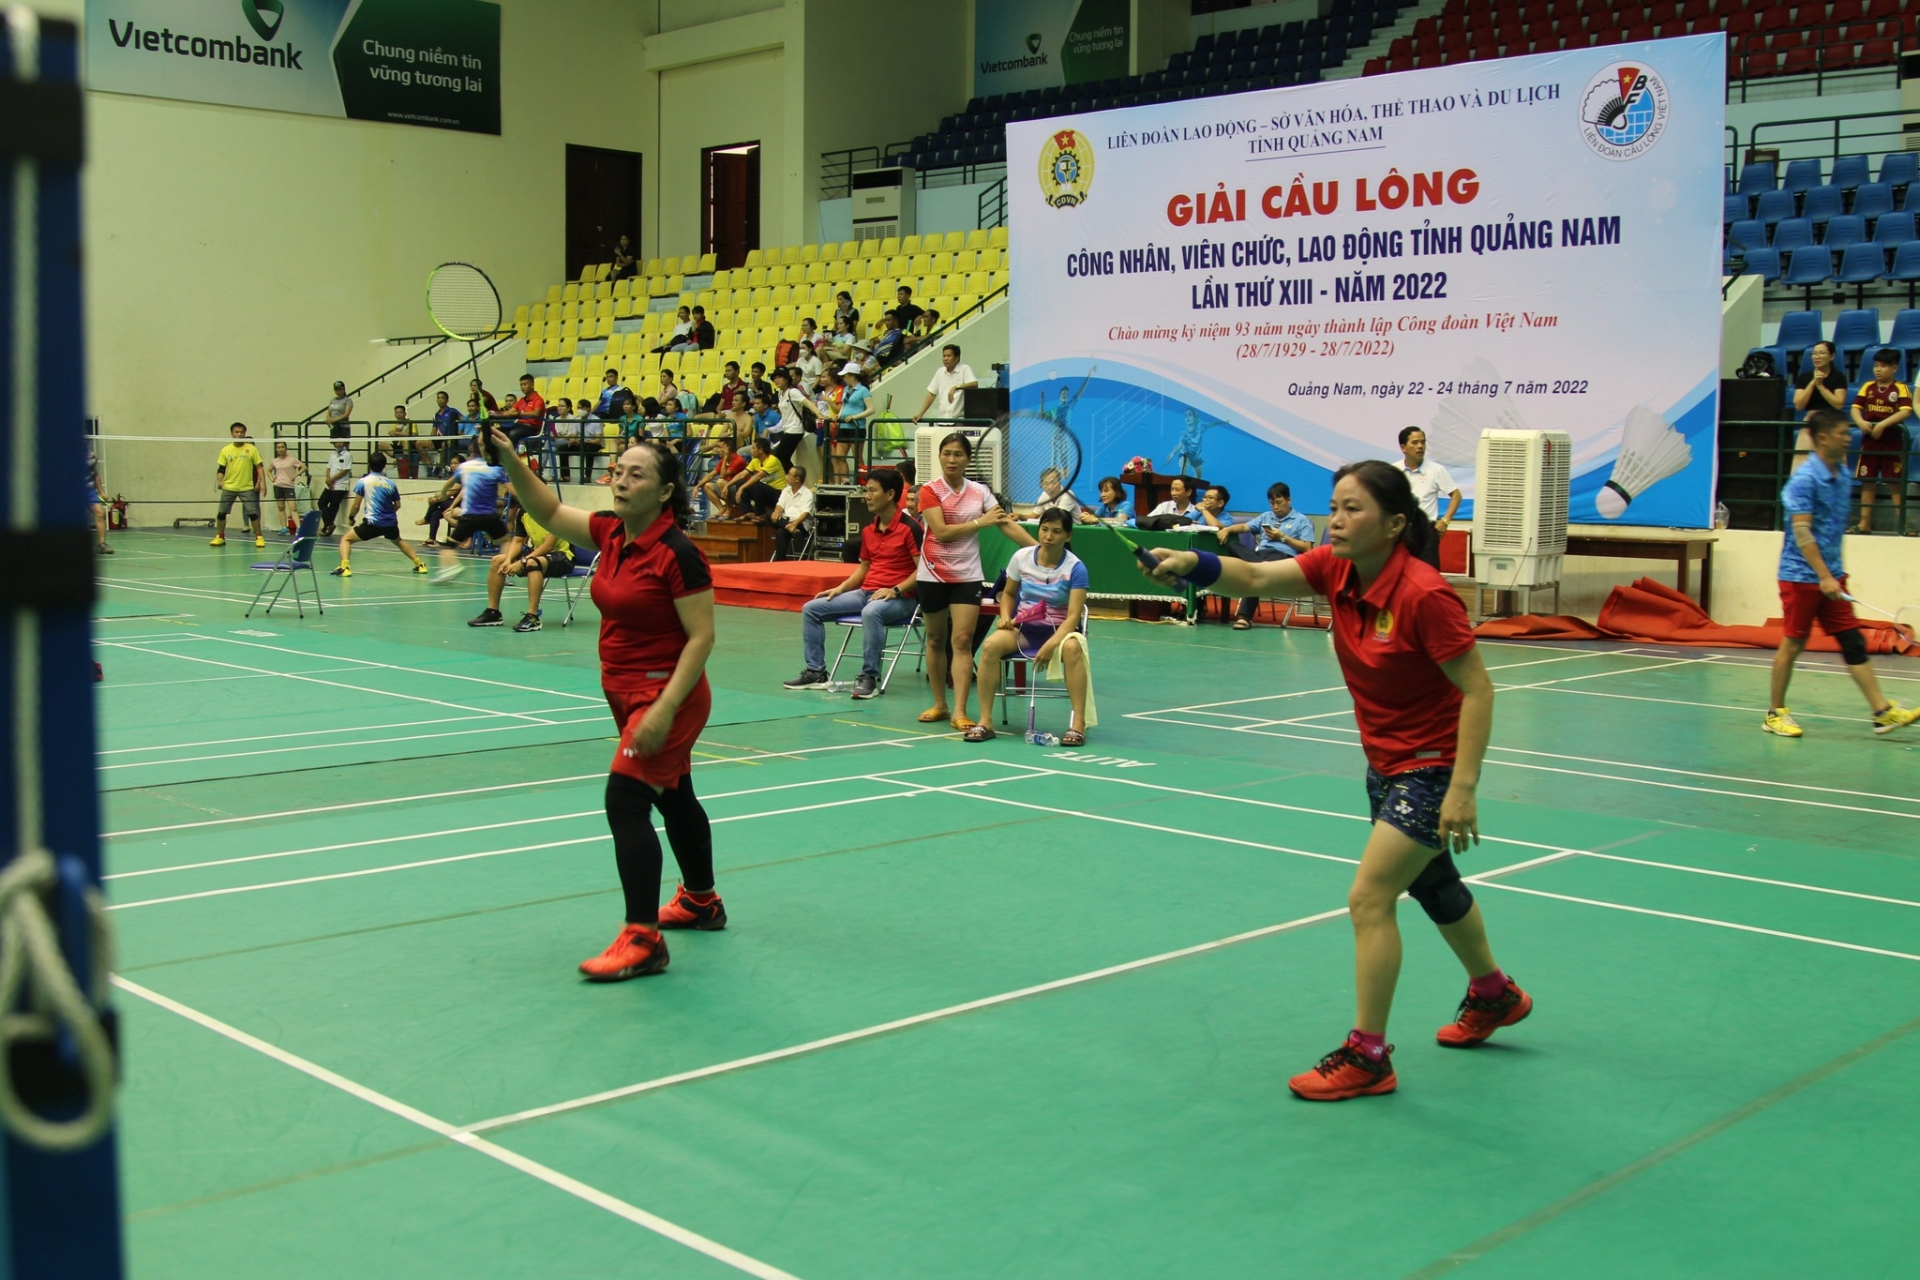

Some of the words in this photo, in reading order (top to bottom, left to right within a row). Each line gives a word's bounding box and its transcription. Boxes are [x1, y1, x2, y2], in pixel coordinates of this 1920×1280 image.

[108, 18, 304, 70] Vietcombank
[362, 39, 415, 63] Chung
[419, 47, 458, 66] niềm
[461, 54, 482, 70] tin
[980, 52, 1048, 74] Vietcombank
[370, 64, 411, 86] vững
[414, 70, 461, 92] tương
[465, 76, 482, 92] lai
[1649, 75, 1665, 97] NAM
[387, 112, 460, 125] www.vietcombank.com.vn
[1107, 131, 1138, 150] LIÊN
[1142, 127, 1180, 146] ĐOÀN
[1183, 124, 1212, 141] LAO
[1215, 119, 1257, 139] ĐỘNG
[1271, 111, 1291, 131] SỞ
[1294, 109, 1326, 127] VĂN
[1330, 104, 1368, 124] HÓA,
[1408, 95, 1455, 115] THAO
[1460, 89, 1483, 108] VÀ
[1488, 89, 1511, 106] DU
[1517, 83, 1561, 106] LỊCH
[1248, 135, 1284, 153] TỈNH
[1288, 129, 1343, 152] QUẢNG
[1347, 126, 1383, 144] NAM
[1167, 182, 1246, 227] GIẢI
[1261, 172, 1339, 219] CẦU
[1355, 167, 1480, 212] LÔNG
[1067, 248, 1114, 278] CÔNG
[1119, 243, 1176, 274] NHÂN,
[1181, 239, 1226, 270] VIÊN
[1231, 234, 1291, 267] CHỨC,
[1298, 235, 1336, 264] LAO
[1342, 227, 1403, 265] ĐỘNG
[1410, 219, 1462, 256] TỈNH
[1471, 213, 1553, 256] QUẢNG
[1561, 215, 1621, 248] NAM
[1192, 275, 1229, 310] LẦN
[1235, 275, 1275, 307] THỨ
[1279, 278, 1313, 305] XIII
[1335, 270, 1385, 303] NĂM
[1392, 271, 1448, 301] 2022
[1108, 326, 1139, 341] Chào
[1142, 324, 1179, 342] mừng
[1199, 322, 1231, 341] niệm
[1235, 321, 1251, 337] 93
[1254, 321, 1283, 336] năm
[1287, 319, 1321, 339] ngày
[1324, 318, 1366, 334] thành
[1369, 316, 1393, 337] lập
[1397, 315, 1437, 335] Công
[1441, 313, 1479, 331] đoàn
[1485, 312, 1516, 333] Việt
[1519, 311, 1558, 328] Nam
[1236, 341, 1307, 361] (28/7/1929
[1320, 339, 1395, 359] 28/7/2022)
[1288, 381, 1329, 398] Quảng
[1333, 382, 1366, 398] Nam,
[1371, 381, 1404, 398] ngày
[1408, 381, 1425, 395] 22
[1436, 381, 1453, 395] 24
[1457, 380, 1498, 398] tháng
[1503, 380, 1513, 394] 7
[1516, 380, 1547, 395] năm
[1552, 380, 1589, 394] 2022
